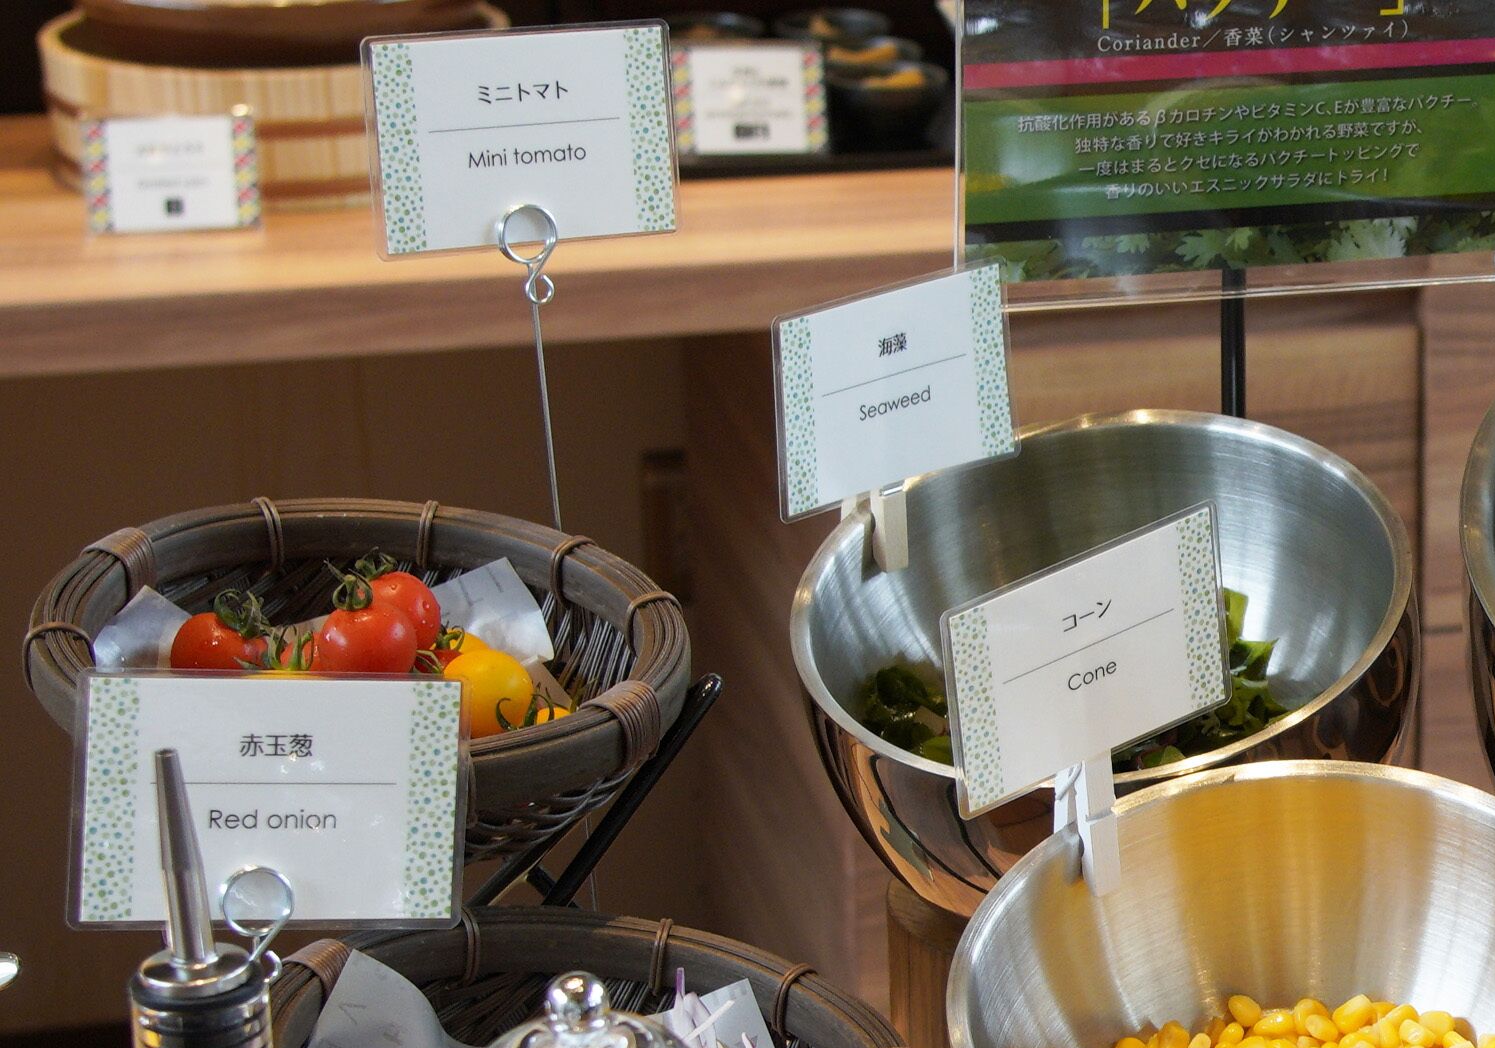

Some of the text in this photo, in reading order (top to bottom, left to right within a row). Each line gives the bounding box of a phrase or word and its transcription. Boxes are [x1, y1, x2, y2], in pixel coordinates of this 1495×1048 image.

[477, 80, 569, 105] ミニトマト
[467, 143, 587, 169] Mini tomato
[877, 332, 909, 358] 海藻
[859, 385, 932, 422] Seaweed
[1061, 599, 1113, 633] コーン
[1067, 660, 1118, 692] Cone
[239, 733, 314, 758] 赤玉葱
[208, 808, 337, 830] Red onion
